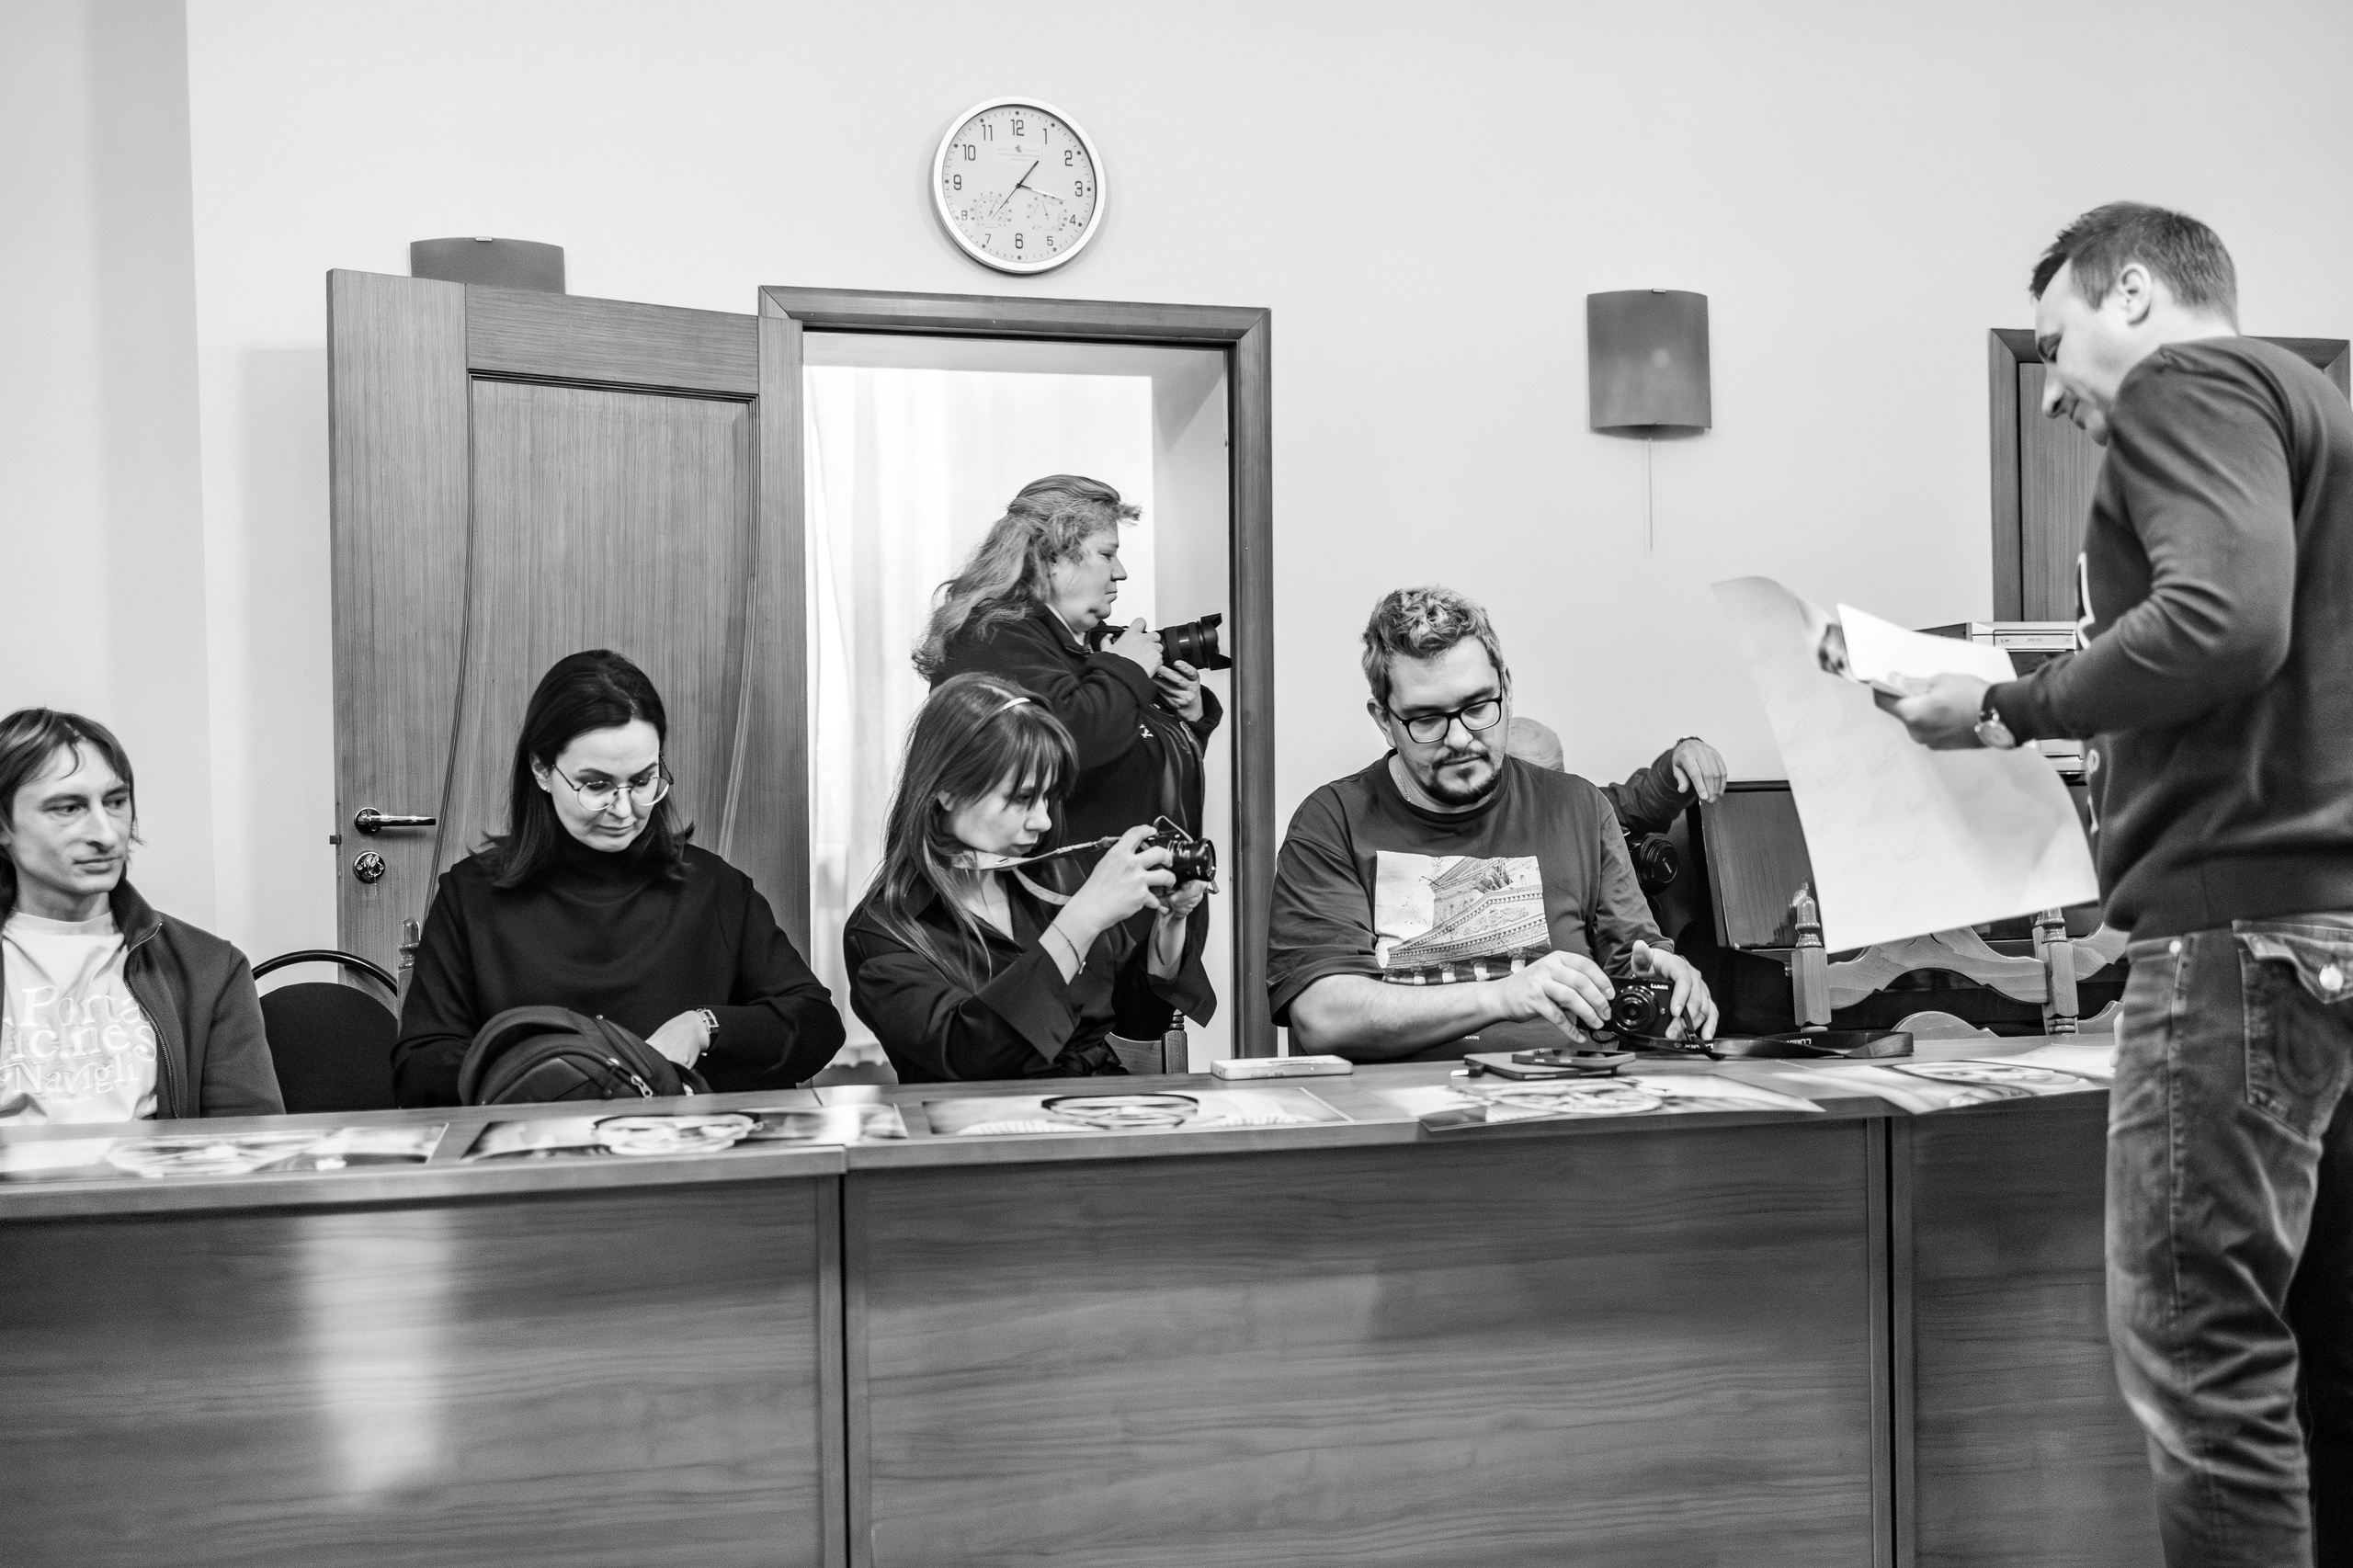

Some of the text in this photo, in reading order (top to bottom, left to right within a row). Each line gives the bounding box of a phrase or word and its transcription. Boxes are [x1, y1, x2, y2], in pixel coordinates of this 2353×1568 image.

[983, 125, 993, 141] 11
[1011, 119, 1024, 136] 12
[1043, 129, 1048, 143] 1
[962, 145, 975, 161] 10
[1064, 151, 1073, 166] 2
[954, 175, 961, 190] 9
[1075, 181, 1083, 197] 3
[961, 210, 967, 220] 8
[1070, 215, 1075, 224] 4
[984, 233, 991, 244] 7
[1016, 233, 1023, 248] 6
[1047, 236, 1053, 246] 5
[4, 1017, 157, 1062] icines
[0, 1053, 140, 1095] Navigli
